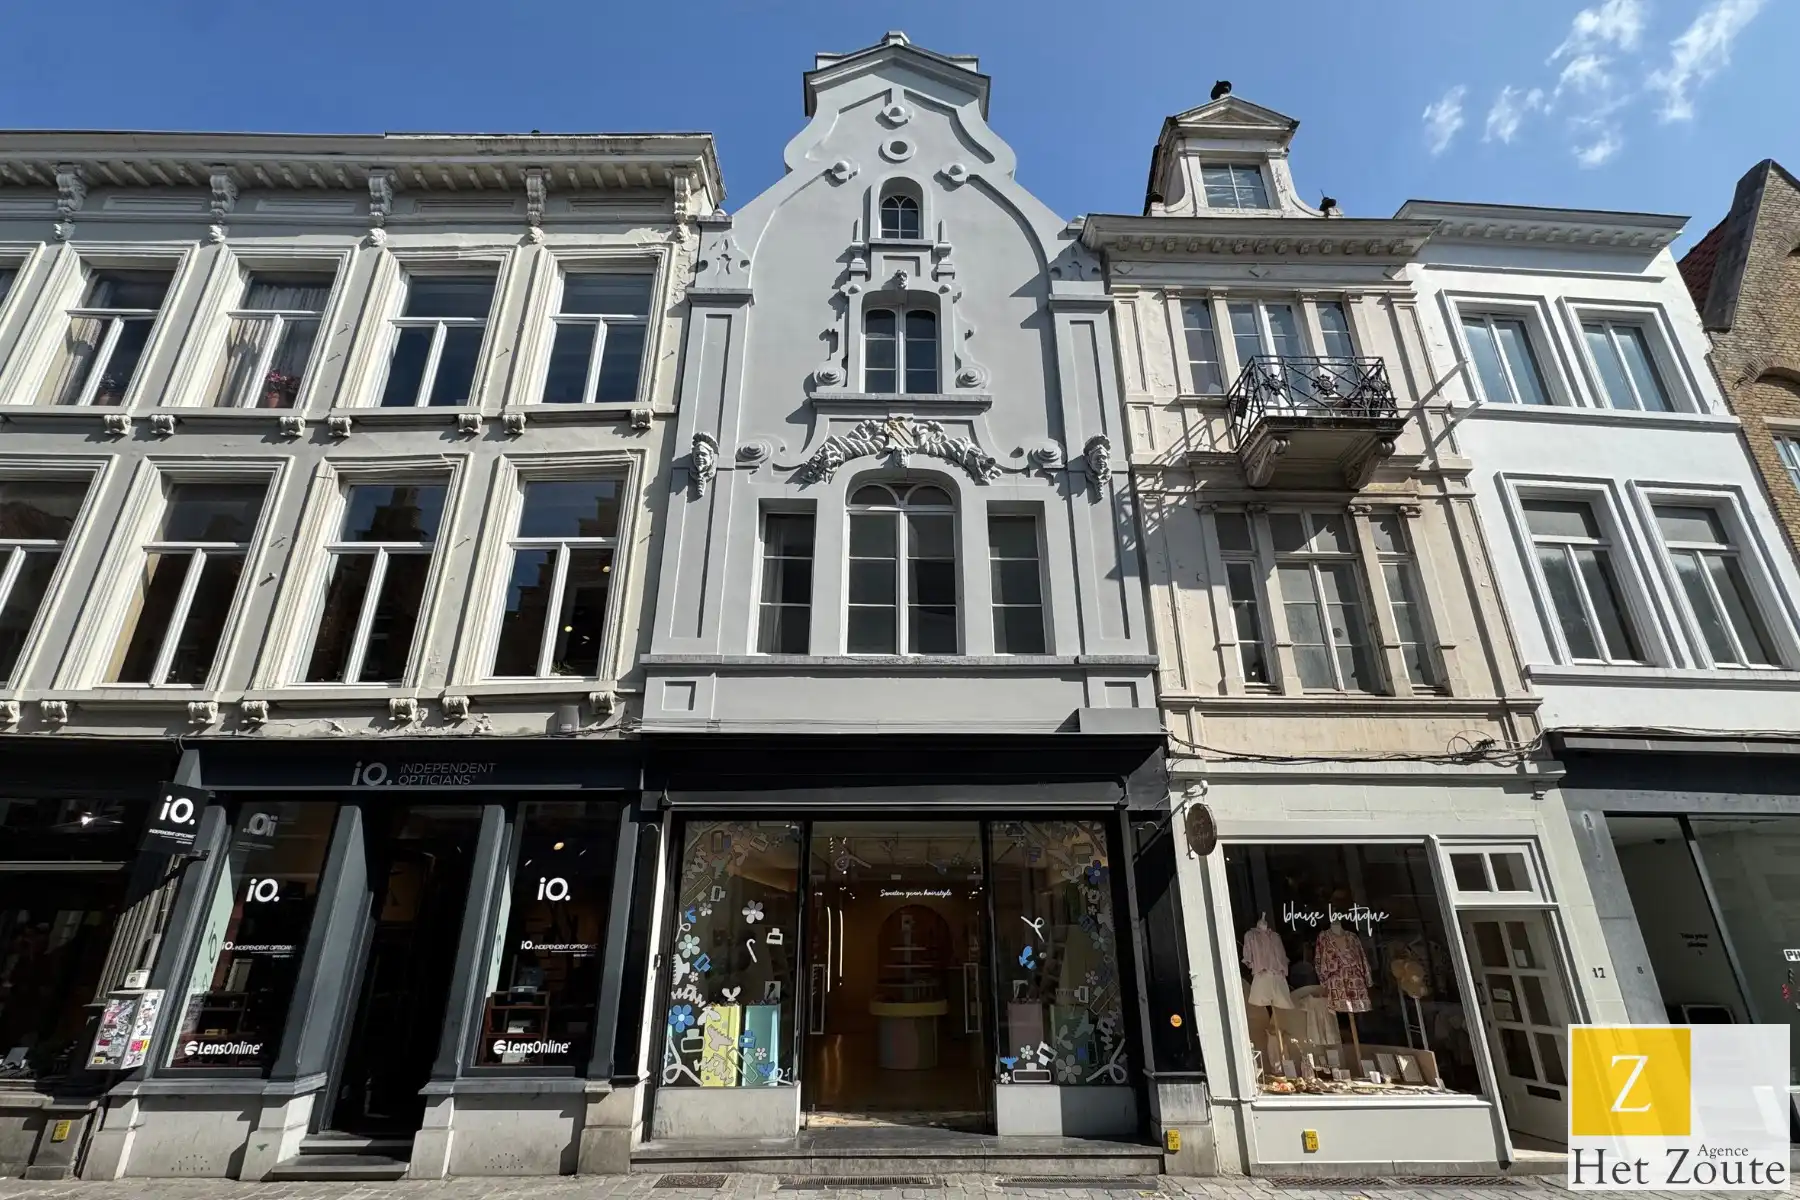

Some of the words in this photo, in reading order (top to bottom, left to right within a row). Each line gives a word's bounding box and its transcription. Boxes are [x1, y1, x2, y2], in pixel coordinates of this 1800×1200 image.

[400, 762, 497, 774] INDEPENDENT
[1328, 902, 1390, 937] boutique
[199, 1041, 261, 1055] LensOnline
[507, 1040, 569, 1054] LensOnline
